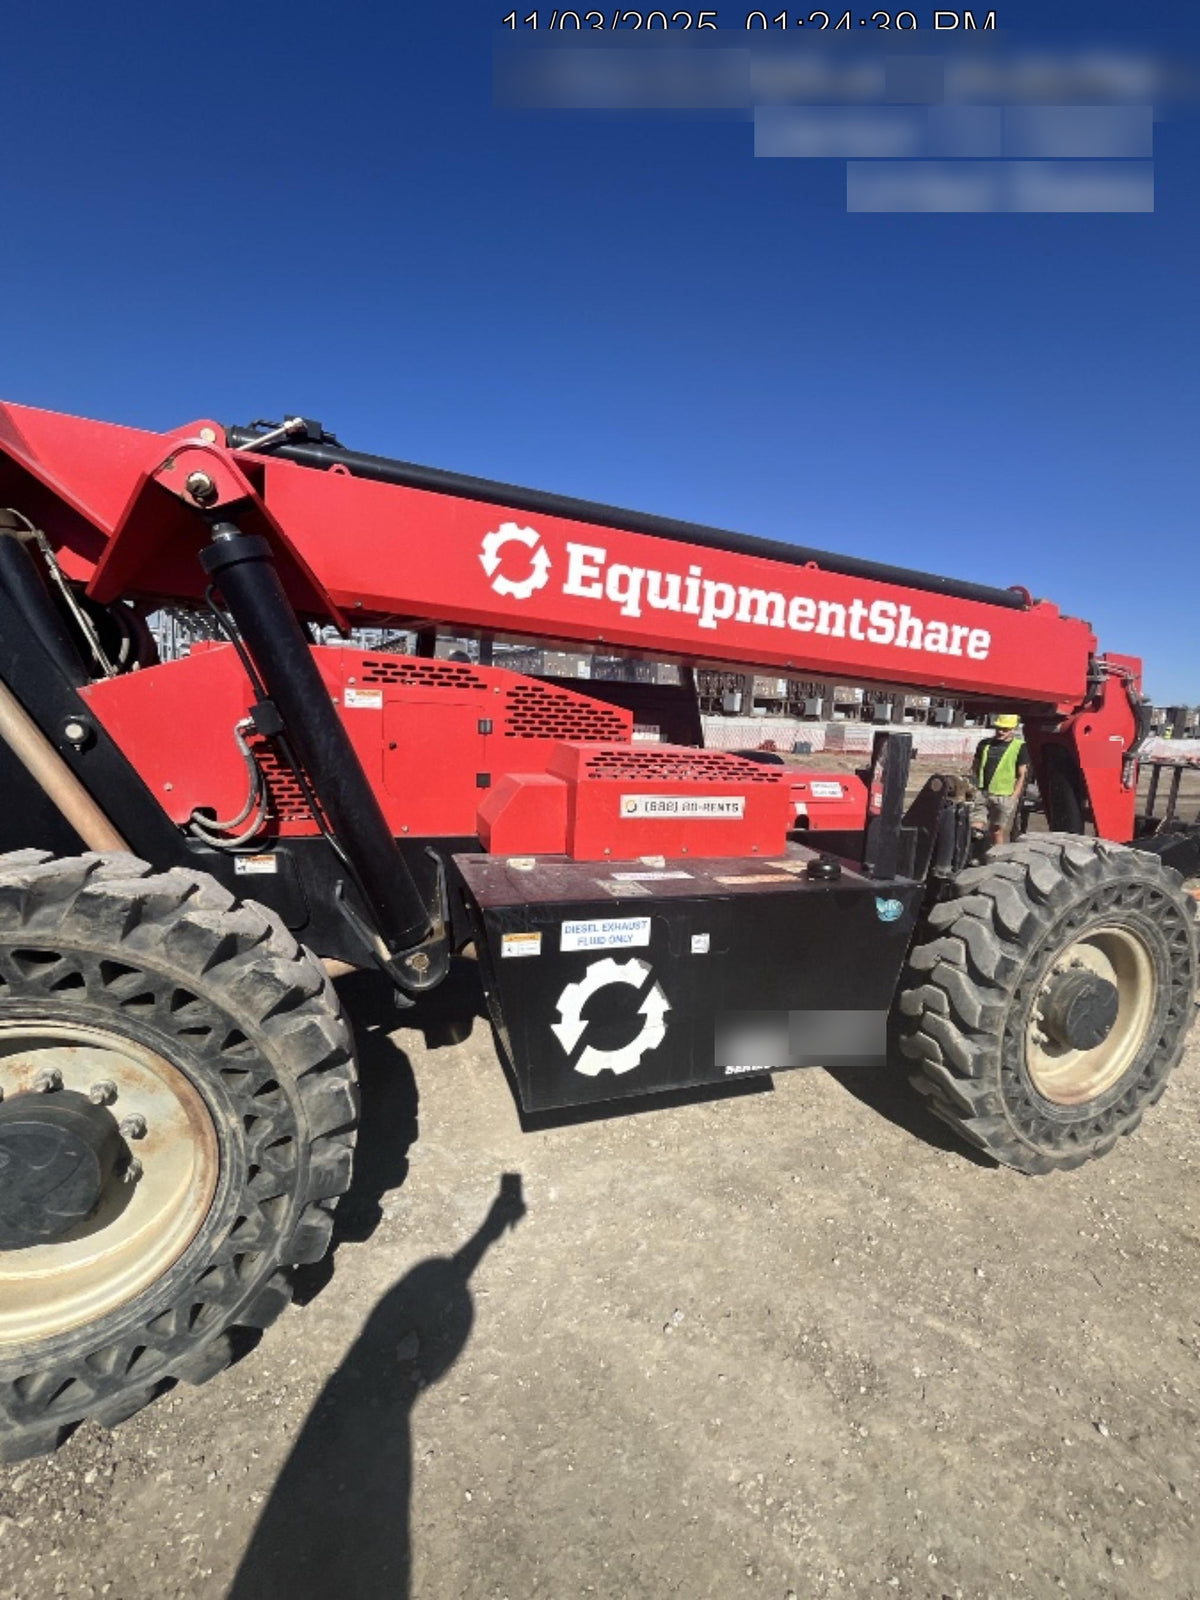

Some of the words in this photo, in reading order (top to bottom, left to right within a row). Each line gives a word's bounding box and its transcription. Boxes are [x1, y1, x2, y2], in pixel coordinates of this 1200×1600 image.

[562, 542, 991, 661] EquipmentShare
[564, 923, 599, 935] DIESEL
[602, 920, 648, 933] EXHAUST
[577, 936, 607, 946] FLUID
[608, 934, 634, 945] ONLY
